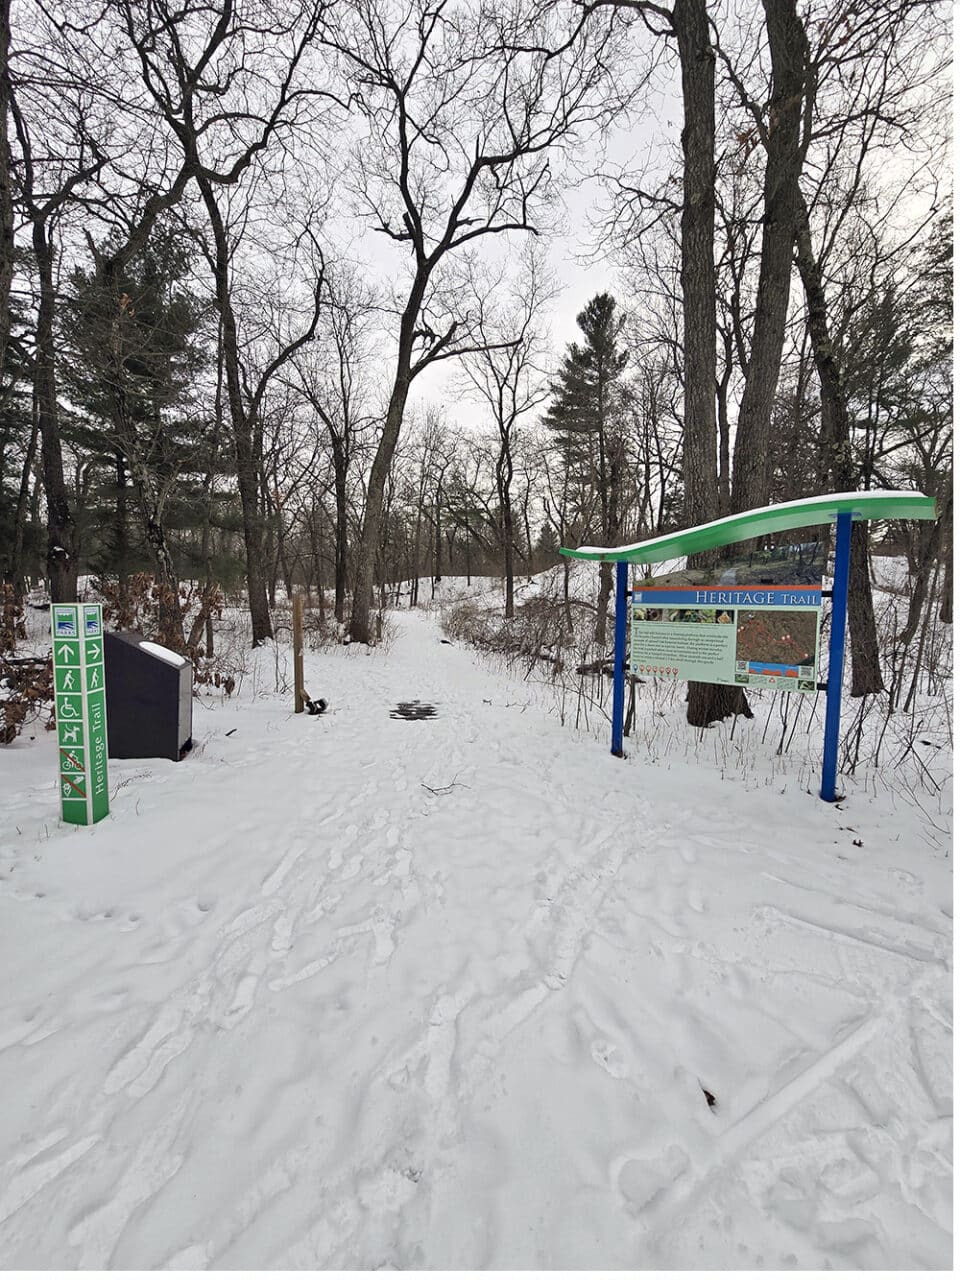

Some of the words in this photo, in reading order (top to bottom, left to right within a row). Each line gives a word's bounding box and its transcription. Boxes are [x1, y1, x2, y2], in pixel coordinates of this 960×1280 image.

[695, 591, 774, 604] HERITAGE
[781, 593, 818, 605] TRAIL
[92, 703, 102, 732] Trail
[95, 736, 104, 795] Heritage
